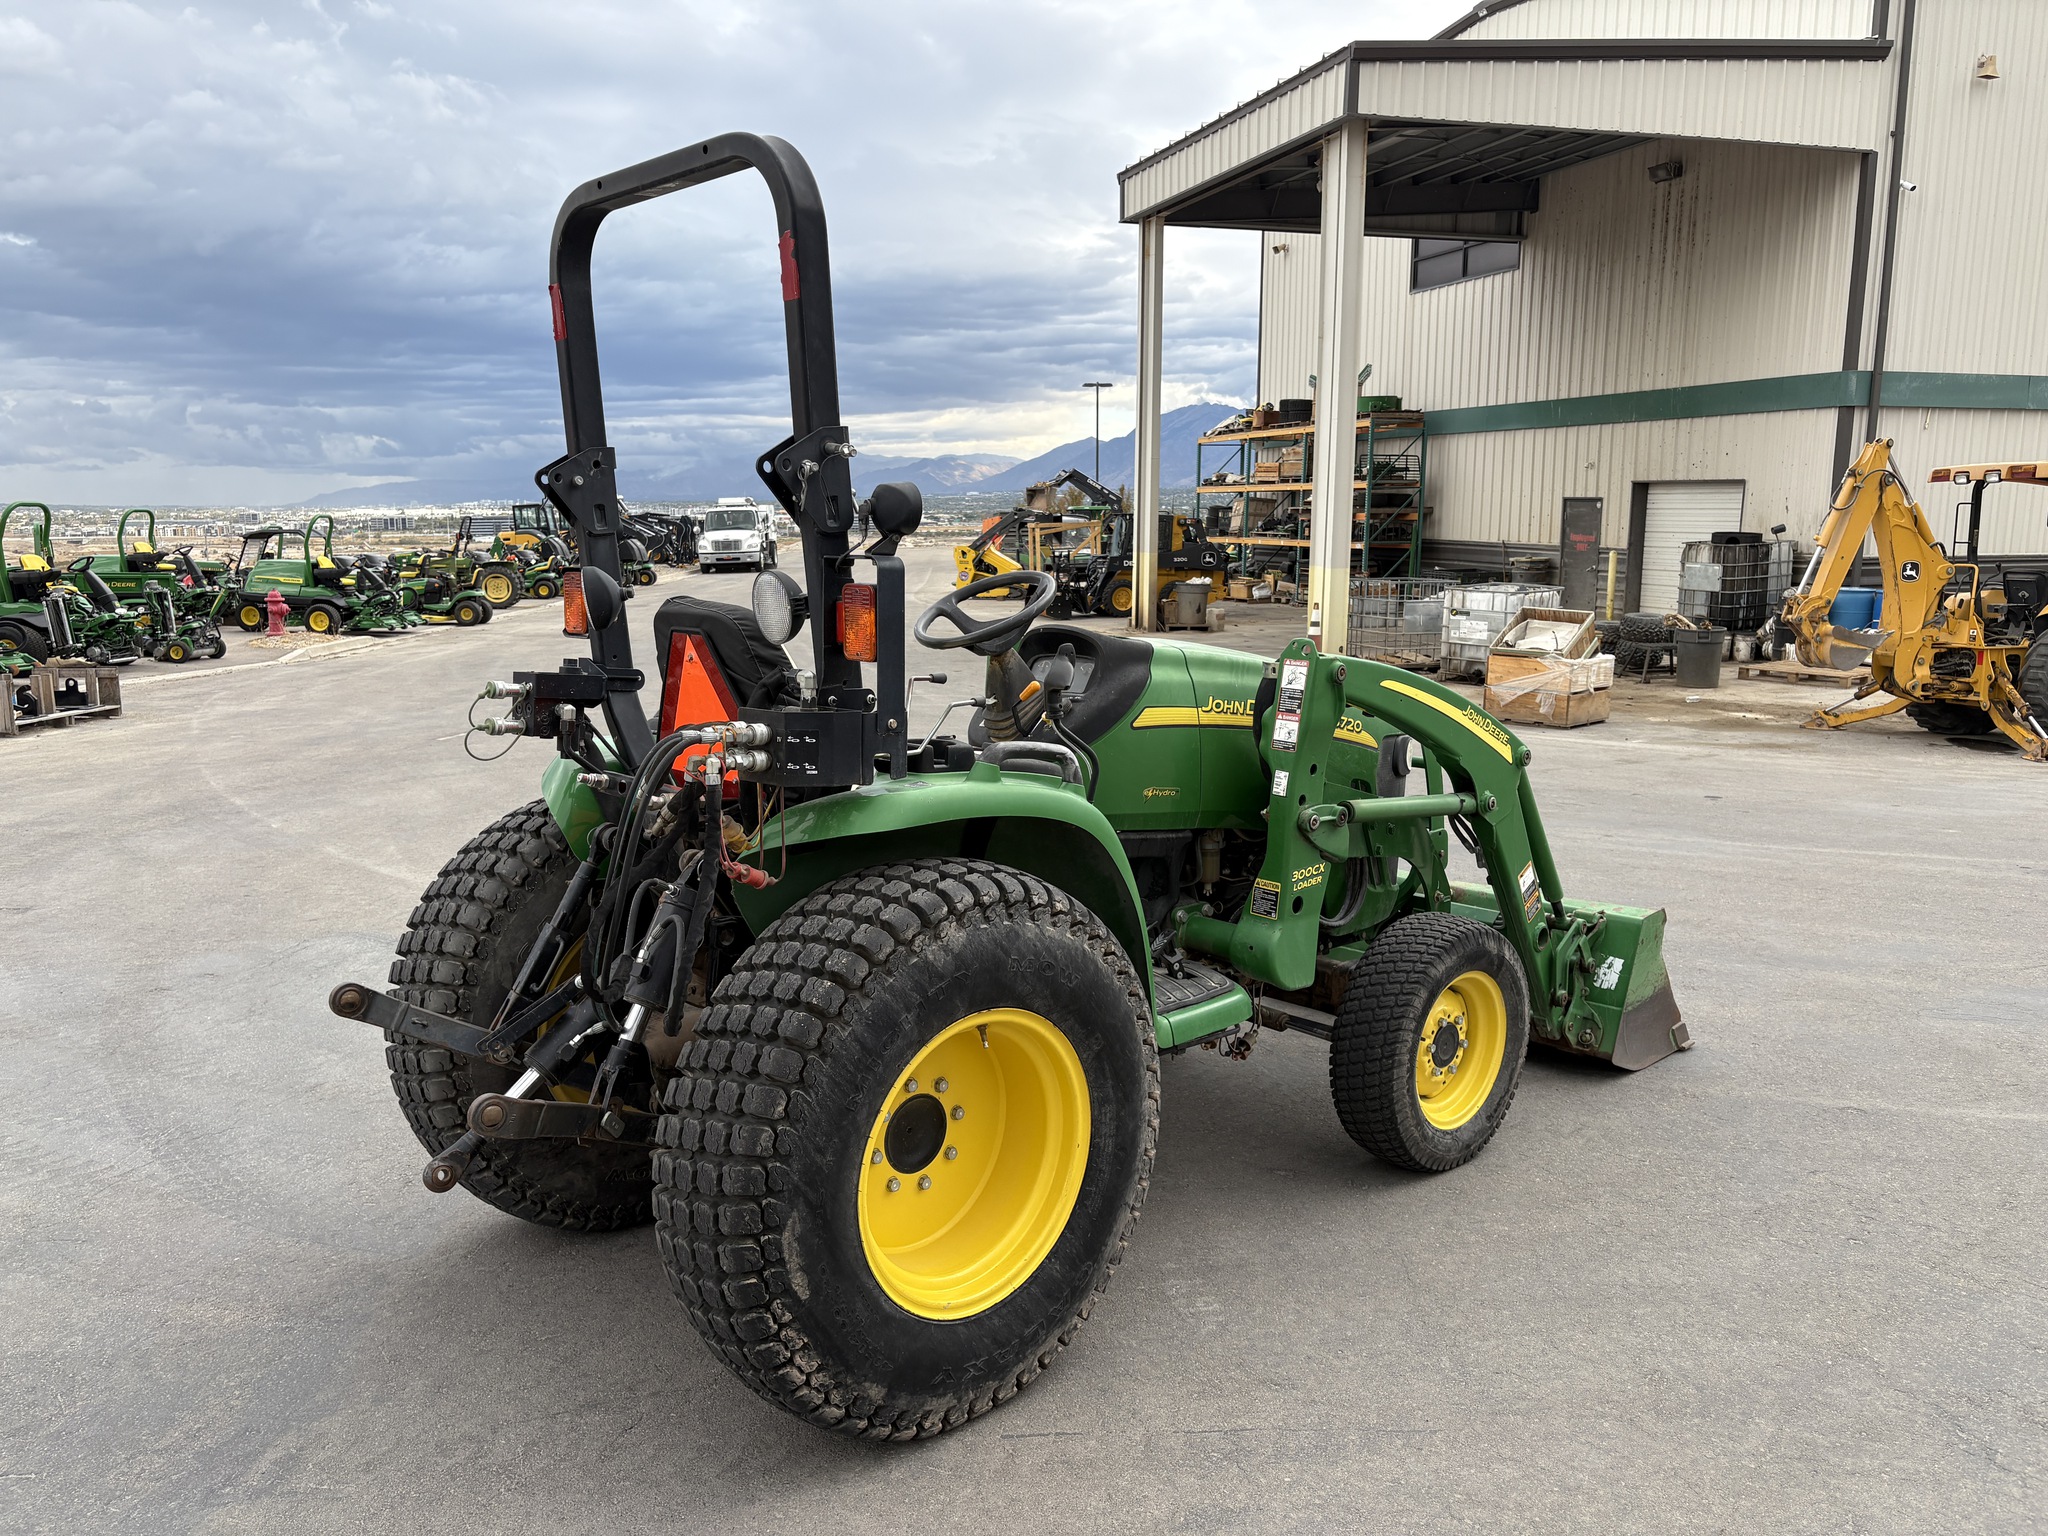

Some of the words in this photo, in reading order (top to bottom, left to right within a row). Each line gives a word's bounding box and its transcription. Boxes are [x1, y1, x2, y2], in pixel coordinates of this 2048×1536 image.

[1201, 695, 1245, 714] JOHN
[1462, 704, 1484, 728] JOHN
[1483, 718, 1510, 746] DEERE
[1291, 862, 1326, 882] 300CX
[1260, 880, 1280, 890] CAUTION
[1293, 875, 1323, 892] LOADER
[1008, 955, 1081, 987] MOW
